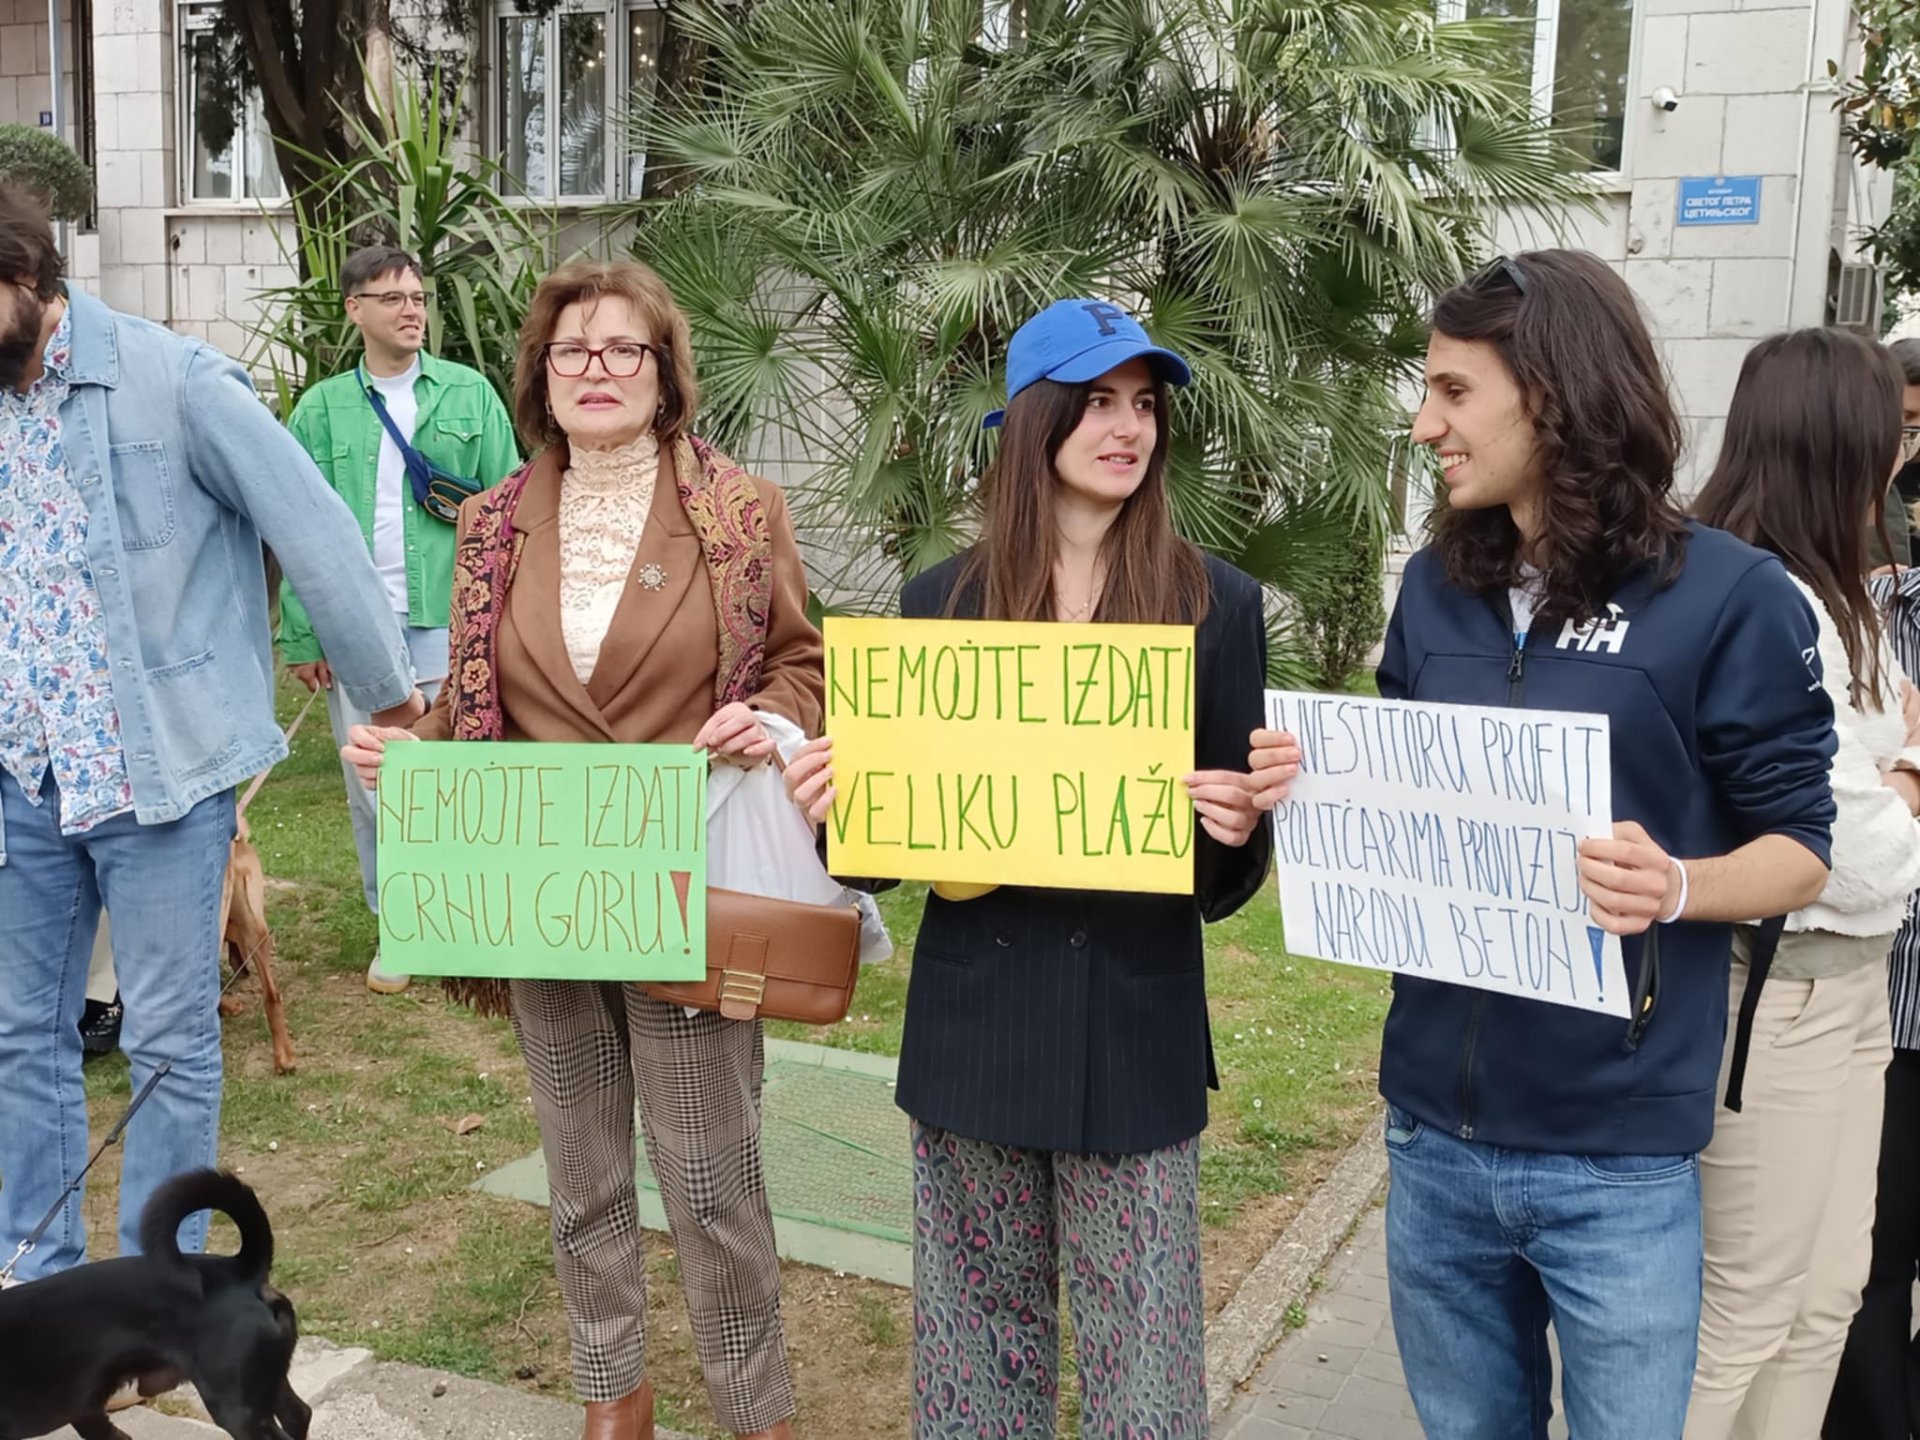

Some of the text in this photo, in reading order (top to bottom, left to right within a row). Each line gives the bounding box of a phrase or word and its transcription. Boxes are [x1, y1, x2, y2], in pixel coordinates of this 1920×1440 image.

[830, 640, 1192, 731] NEMOJTE IZDATI
[379, 761, 702, 852] NEMOJTE IZDATI
[829, 763, 1195, 858] VELIKU PLAŽU
[1481, 717, 1604, 816] PROFIT
[381, 869, 692, 955] CRNU GORU!
[1457, 816, 1590, 917] PROVIZIJ
[1311, 882, 1605, 1002] NARODU BETON!
